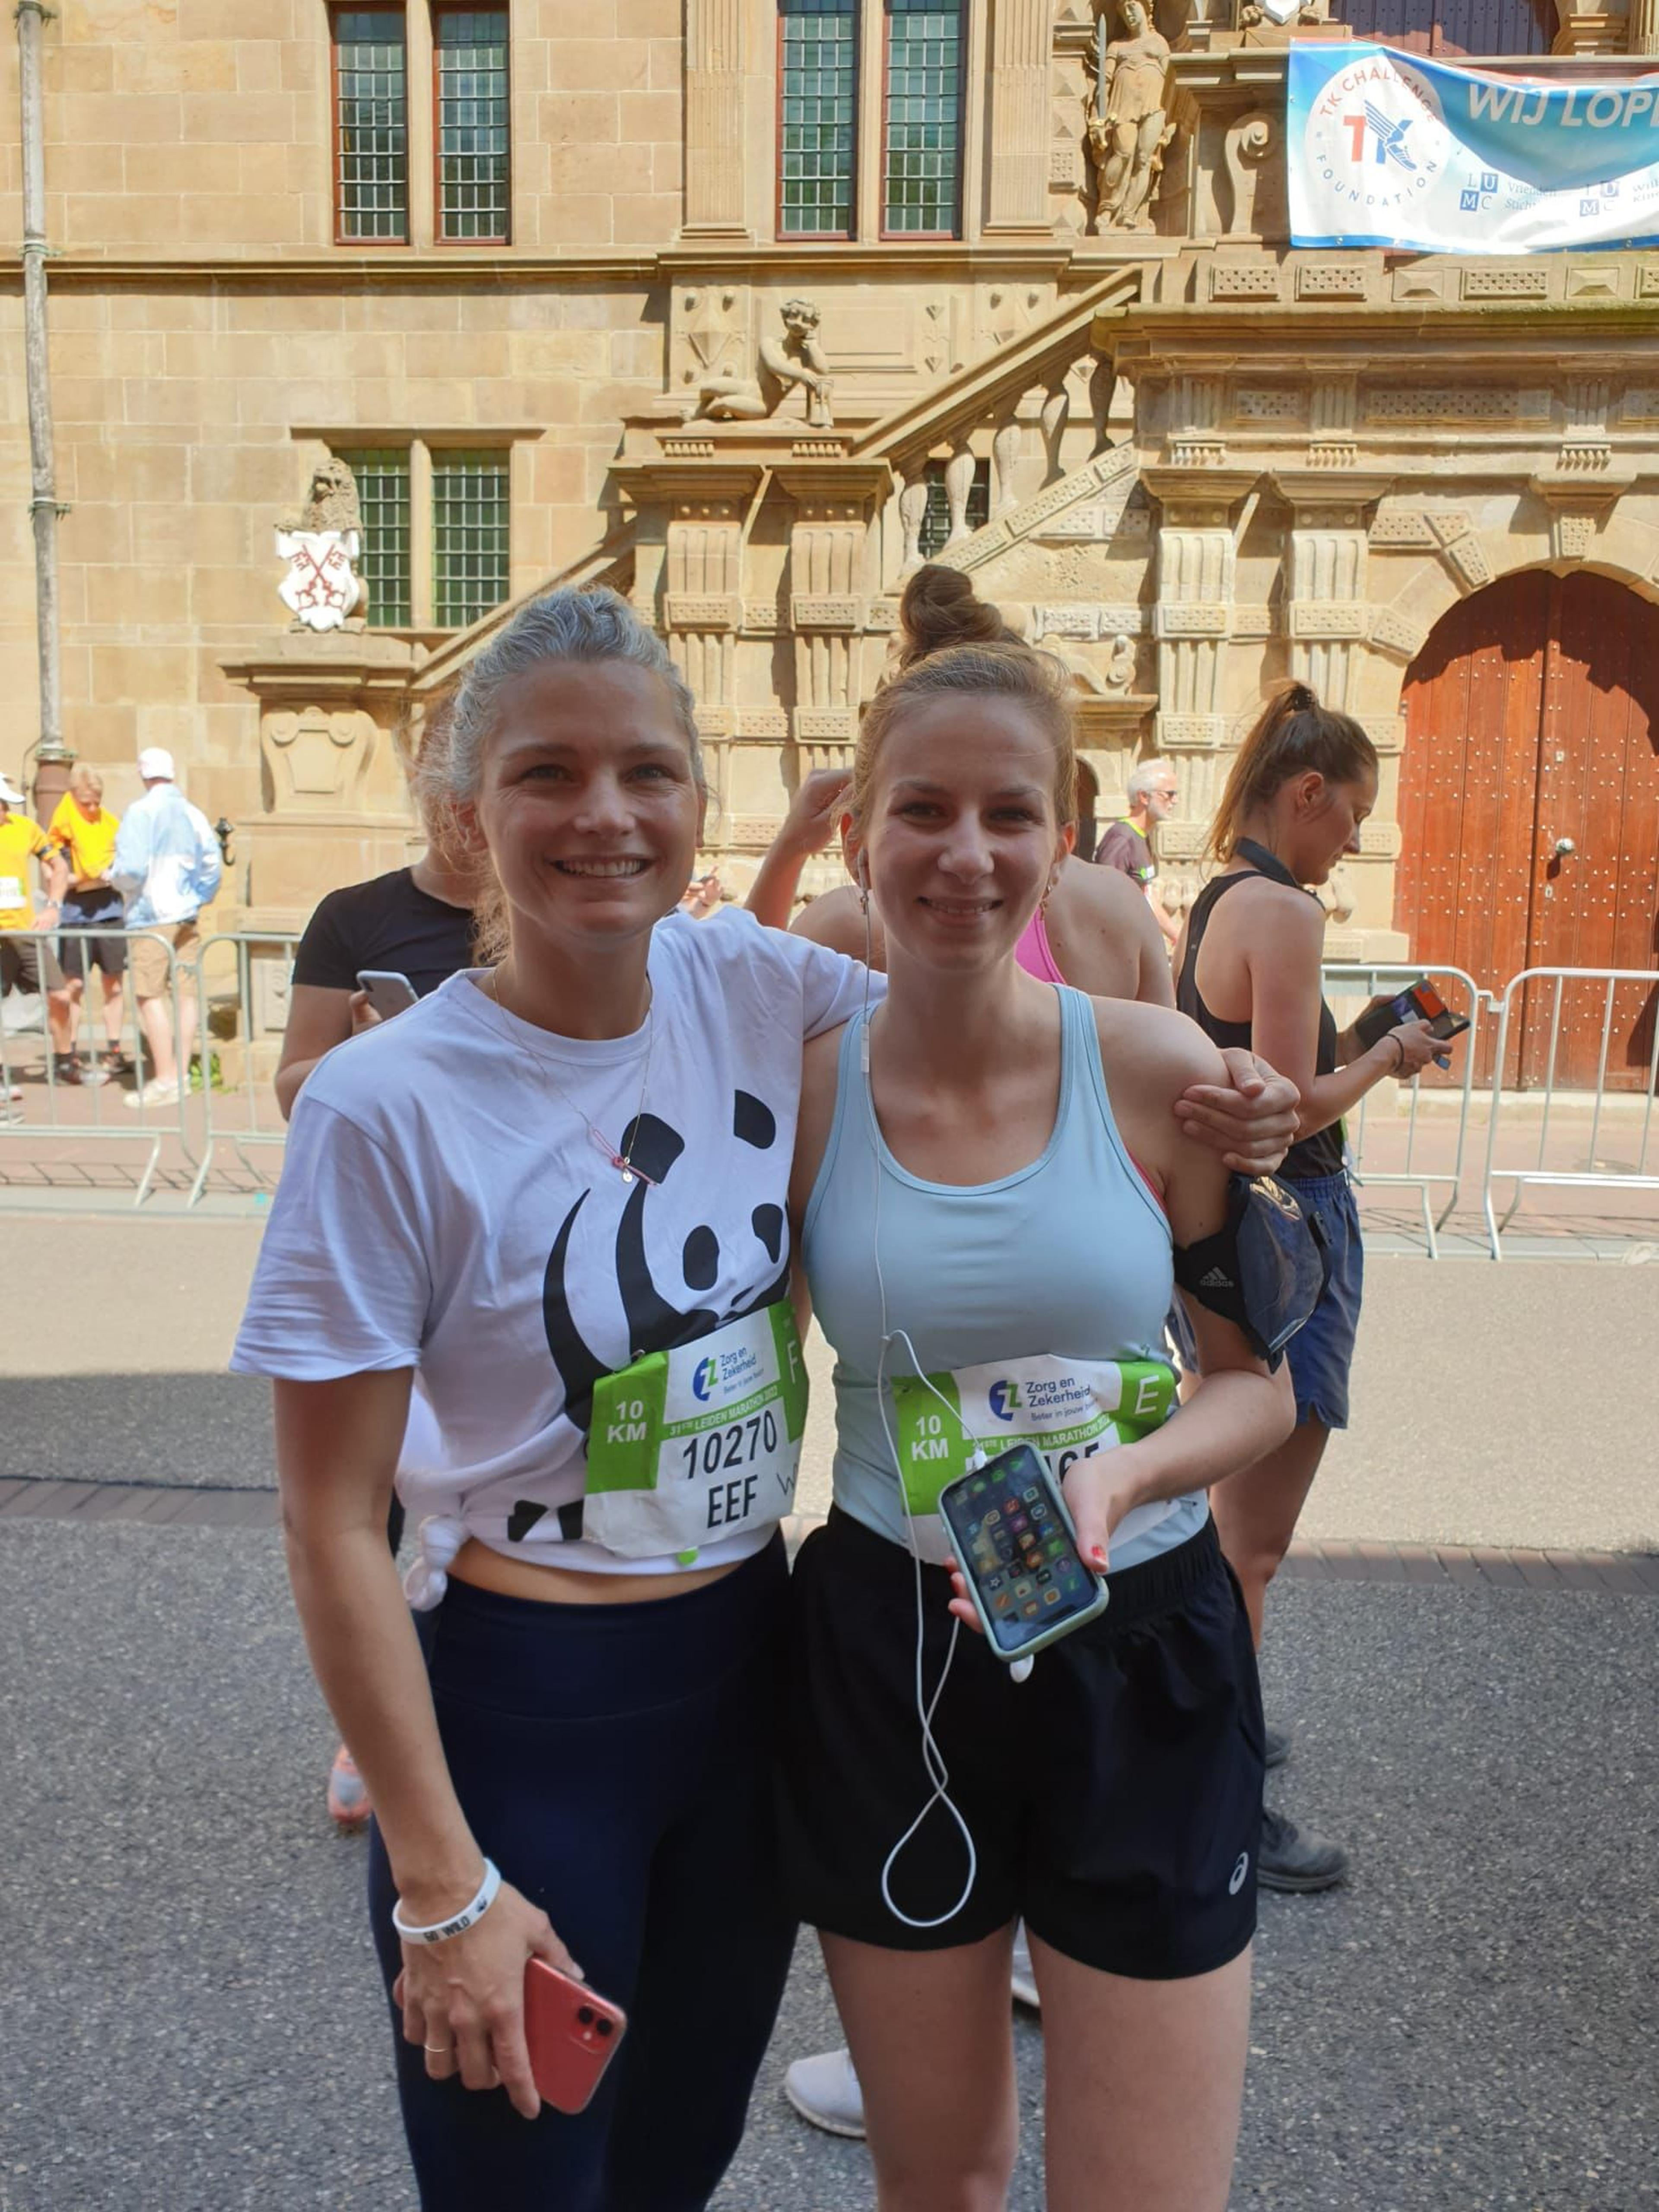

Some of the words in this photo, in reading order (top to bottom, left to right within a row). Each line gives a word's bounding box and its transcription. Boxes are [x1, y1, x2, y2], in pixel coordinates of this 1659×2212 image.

[1470, 83, 1551, 126] WIJ
[1316, 154, 1437, 207] FOUNDATION
[720, 1353, 737, 1367] Zorg
[738, 1347, 747, 1358] en
[722, 1353, 757, 1380] Zekerheid
[1026, 1380, 1056, 1394] Zorg
[1060, 1377, 1075, 1388] en
[1028, 1384, 1091, 1408] Zekerheid
[1135, 1375, 1160, 1415] E
[616, 1400, 644, 1420] 10
[695, 1409, 728, 1430] LEIDEN
[607, 1422, 646, 1443] KM
[915, 1415, 942, 1436] 10
[1042, 1424, 1098, 1446] MARATHON
[683, 1410, 777, 1479] 10270
[911, 1438, 949, 1462] KM
[707, 1475, 758, 1529] EEF
